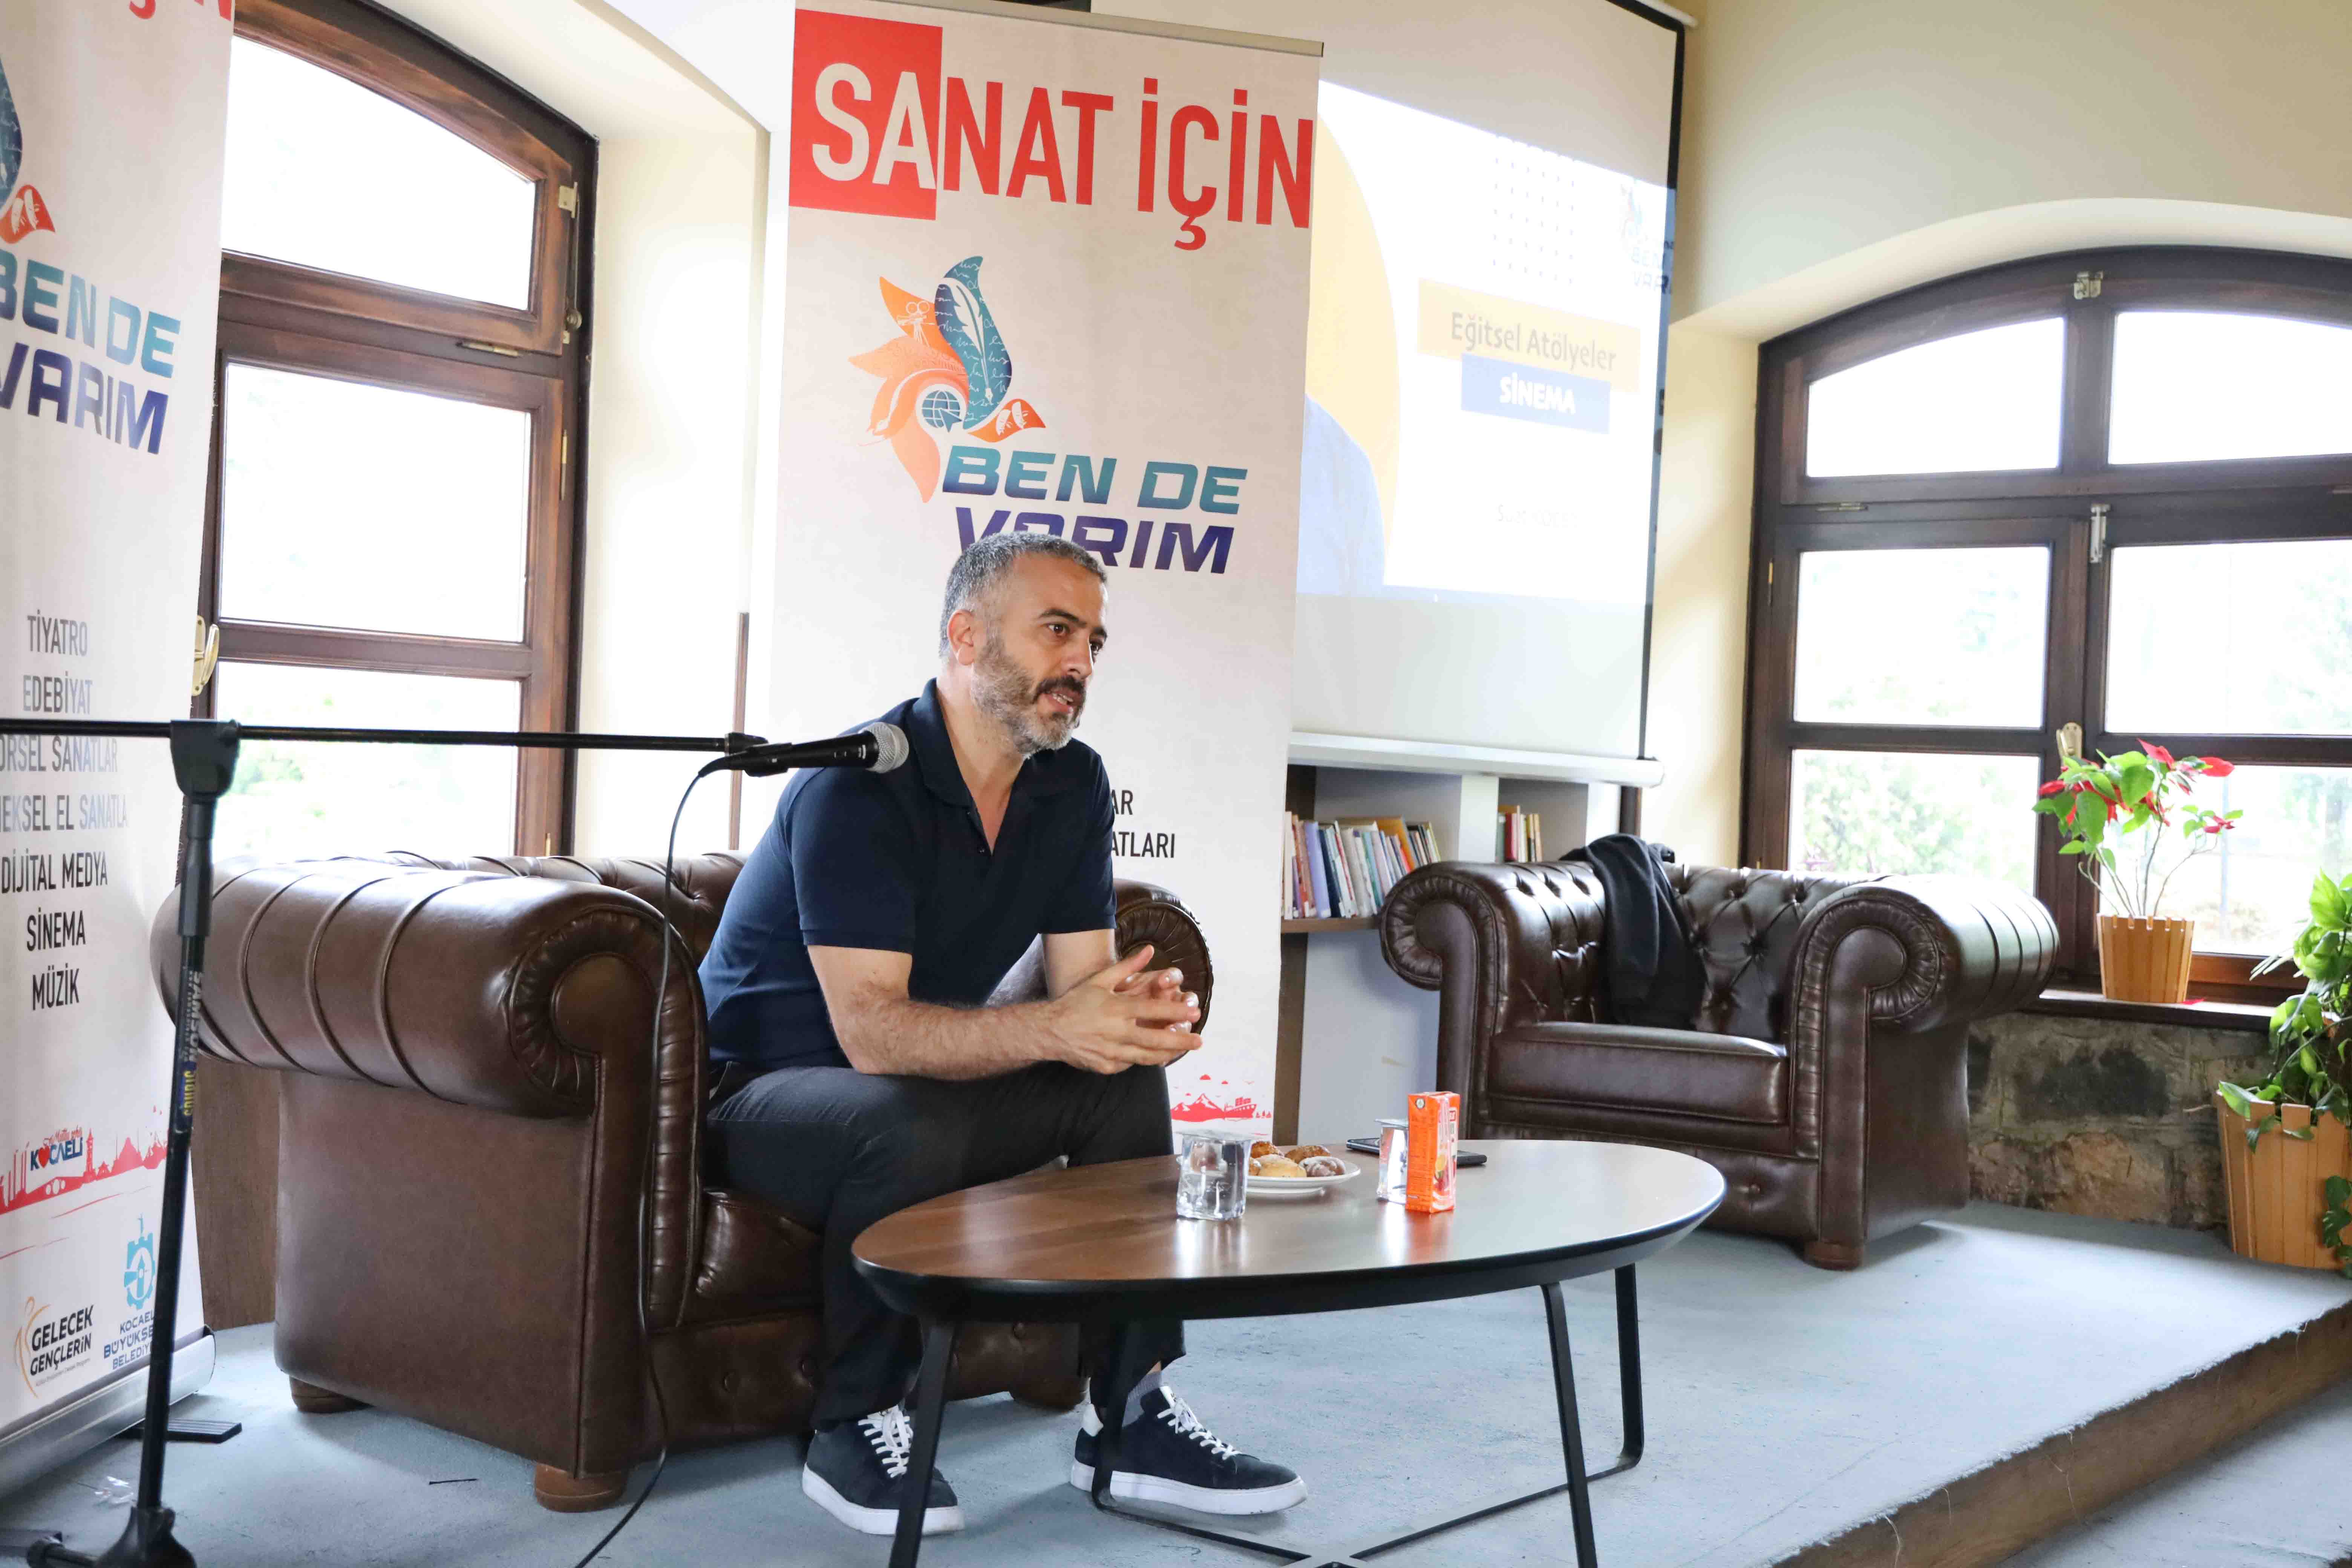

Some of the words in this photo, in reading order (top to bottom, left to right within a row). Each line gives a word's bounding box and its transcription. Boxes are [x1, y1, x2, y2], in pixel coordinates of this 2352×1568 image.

[812, 62, 1114, 205] SANAT
[1137, 77, 1314, 251] İÇİN
[106, 296, 181, 379] DE
[1451, 311, 1521, 352] Eğitsel
[1526, 328, 1617, 371] Atölyeler
[1499, 372, 1576, 415] SİNEMA
[942, 445, 1117, 505] BEN
[1137, 461, 1248, 514] DE
[27, 608, 88, 657] TİYATRO
[23, 670, 93, 715] EDEBİYAT
[57, 794, 75, 831] EL
[1, 848, 56, 894] DİJİTAL
[62, 850, 108, 889] MEDYA
[27, 907, 86, 952] SİNEMA
[32, 963, 79, 1011] MÜZİK
[32, 1304, 94, 1351] GELECEK
